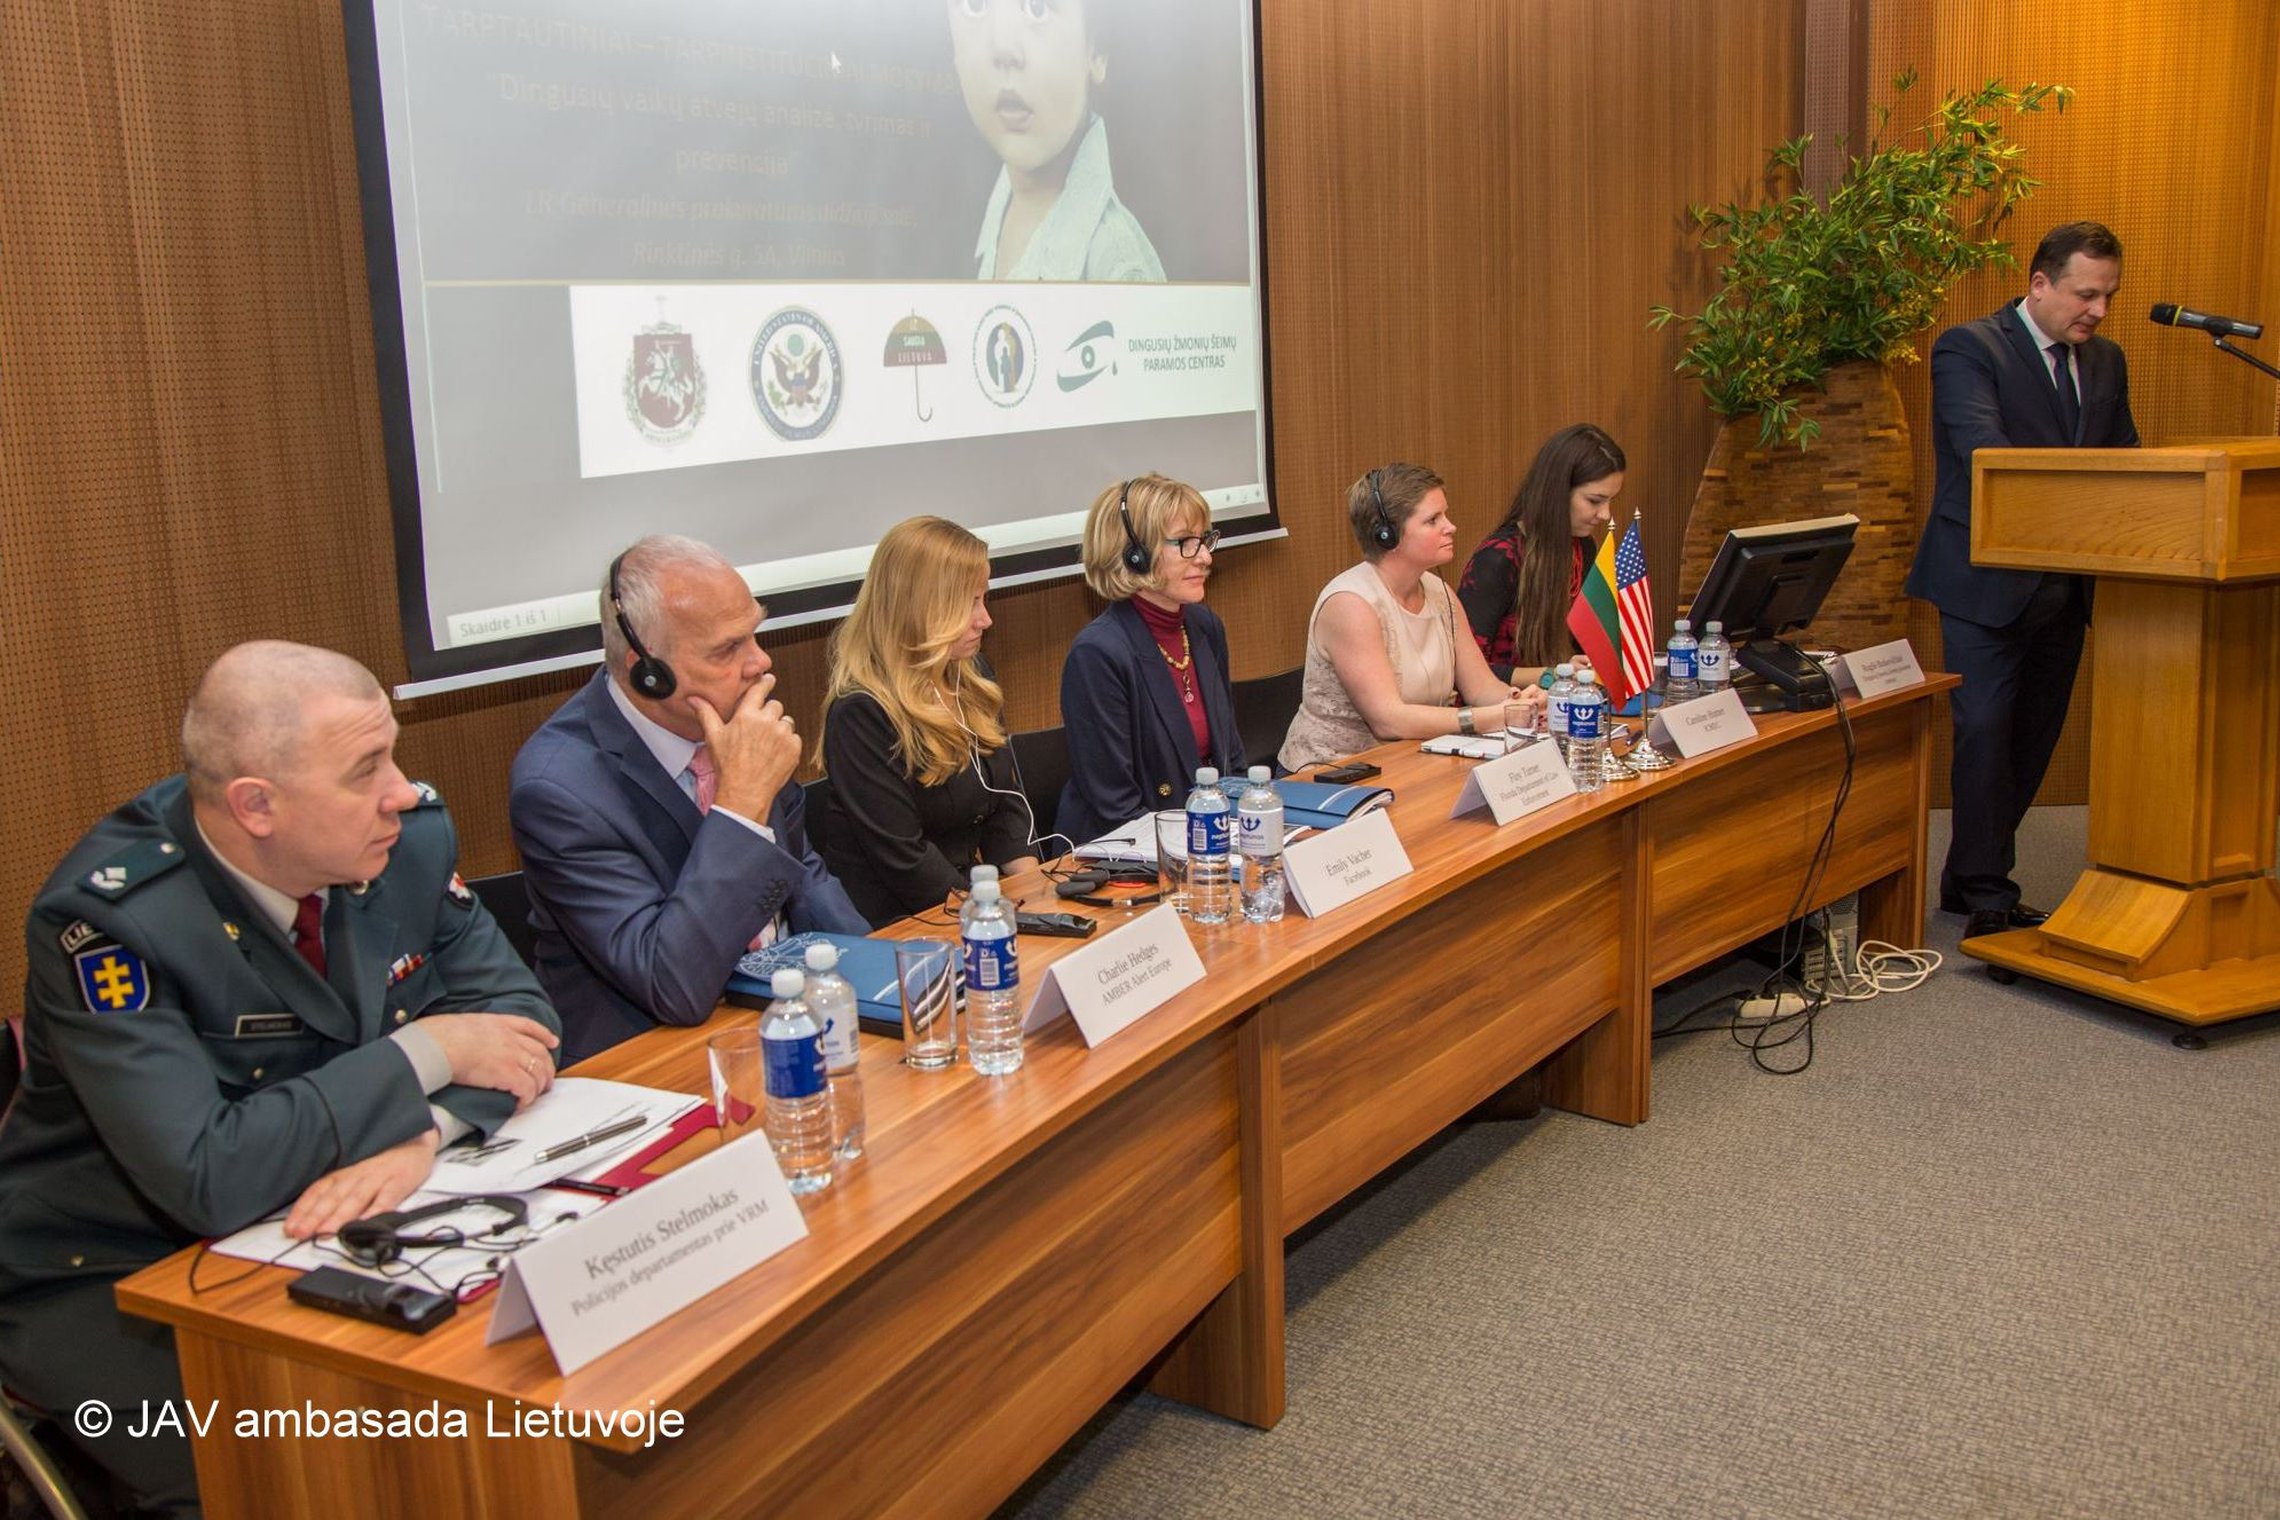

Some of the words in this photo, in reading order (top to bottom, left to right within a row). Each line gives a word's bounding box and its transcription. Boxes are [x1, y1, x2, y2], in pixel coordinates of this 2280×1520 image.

[1144, 356, 1186, 371] PARAMOS
[1188, 355, 1225, 370] CENTRAS
[656, 1188, 740, 1243] Stelmokas
[571, 1278, 630, 1317] Policijos
[714, 1220, 736, 1244] prie
[735, 1199, 771, 1225] VRM
